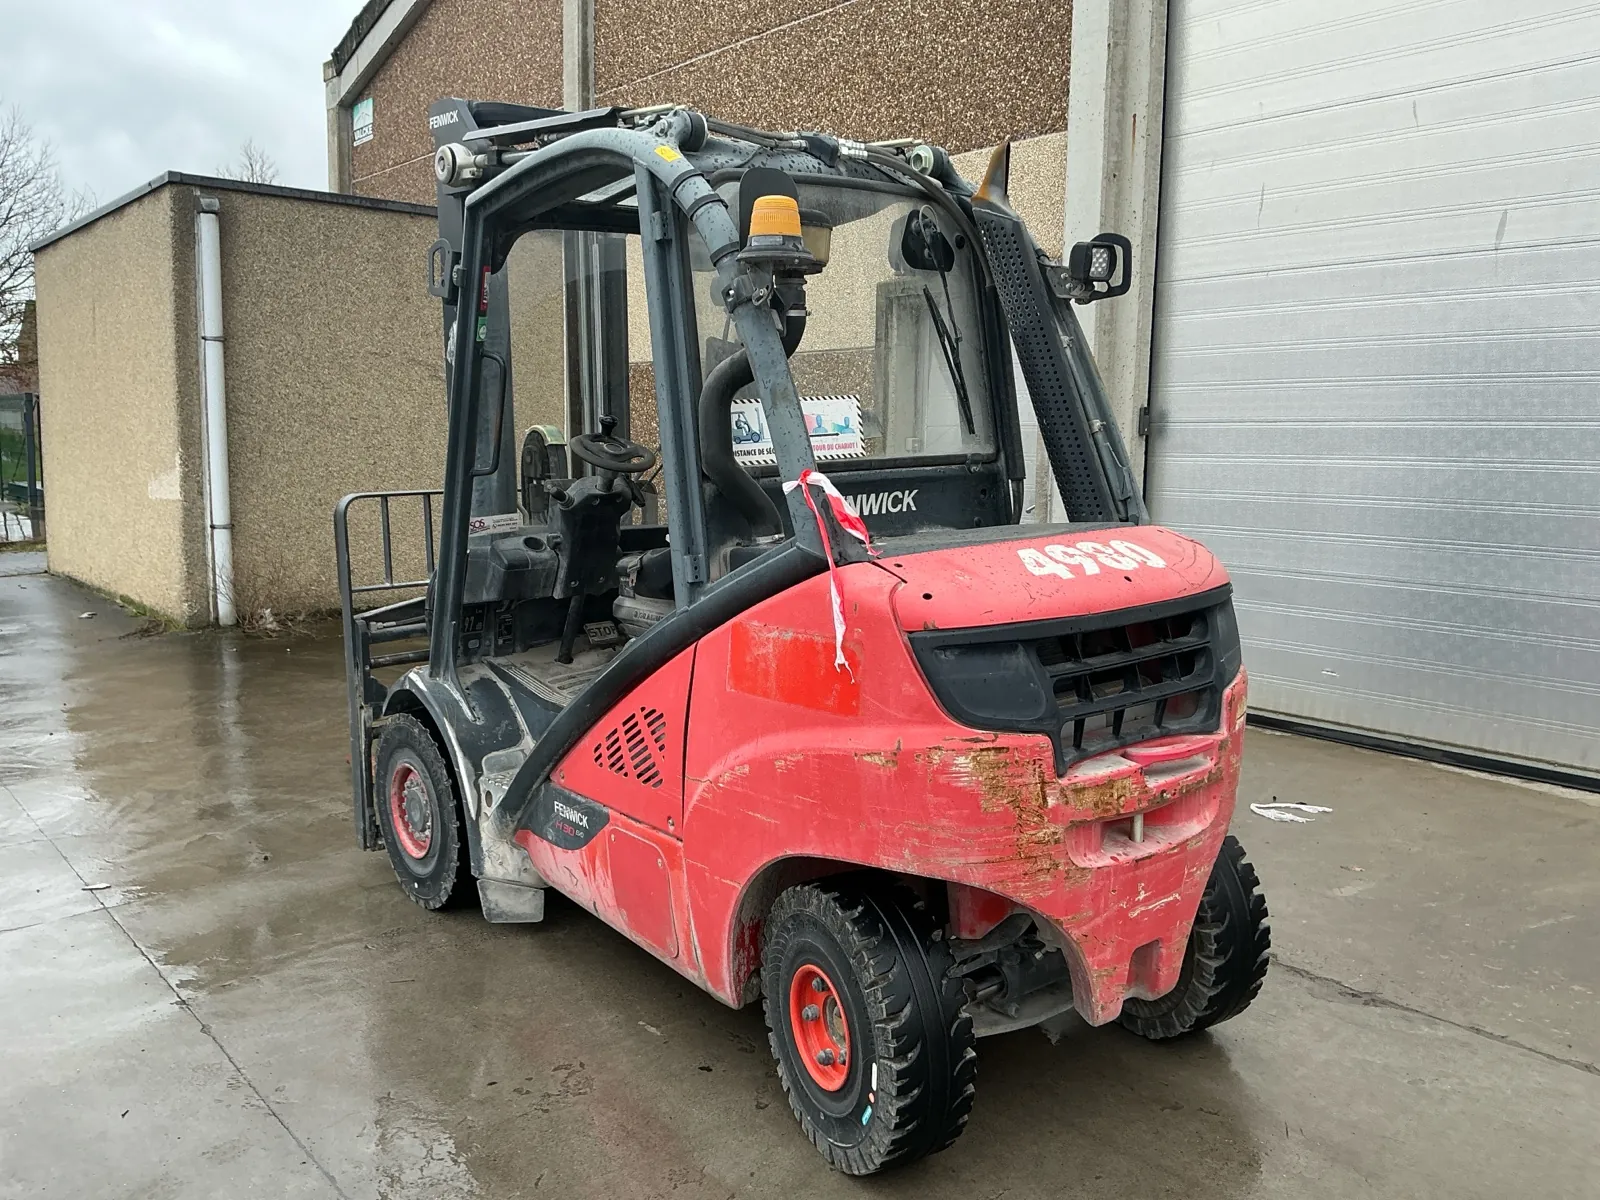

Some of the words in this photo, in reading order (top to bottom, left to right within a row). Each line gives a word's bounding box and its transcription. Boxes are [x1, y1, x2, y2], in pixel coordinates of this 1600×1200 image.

[429, 109, 459, 130] FENWICK
[735, 448, 757, 457] ISTANCE
[757, 447, 765, 456] DE
[813, 443, 826, 452] TOUR
[827, 443, 834, 451] DU
[834, 441, 855, 450] CHARIOT
[843, 489, 919, 516] NWICK
[469, 518, 485, 529] SOS
[1016, 539, 1168, 580] 4980
[587, 625, 616, 638] STOP
[553, 800, 589, 830] FENWICK
